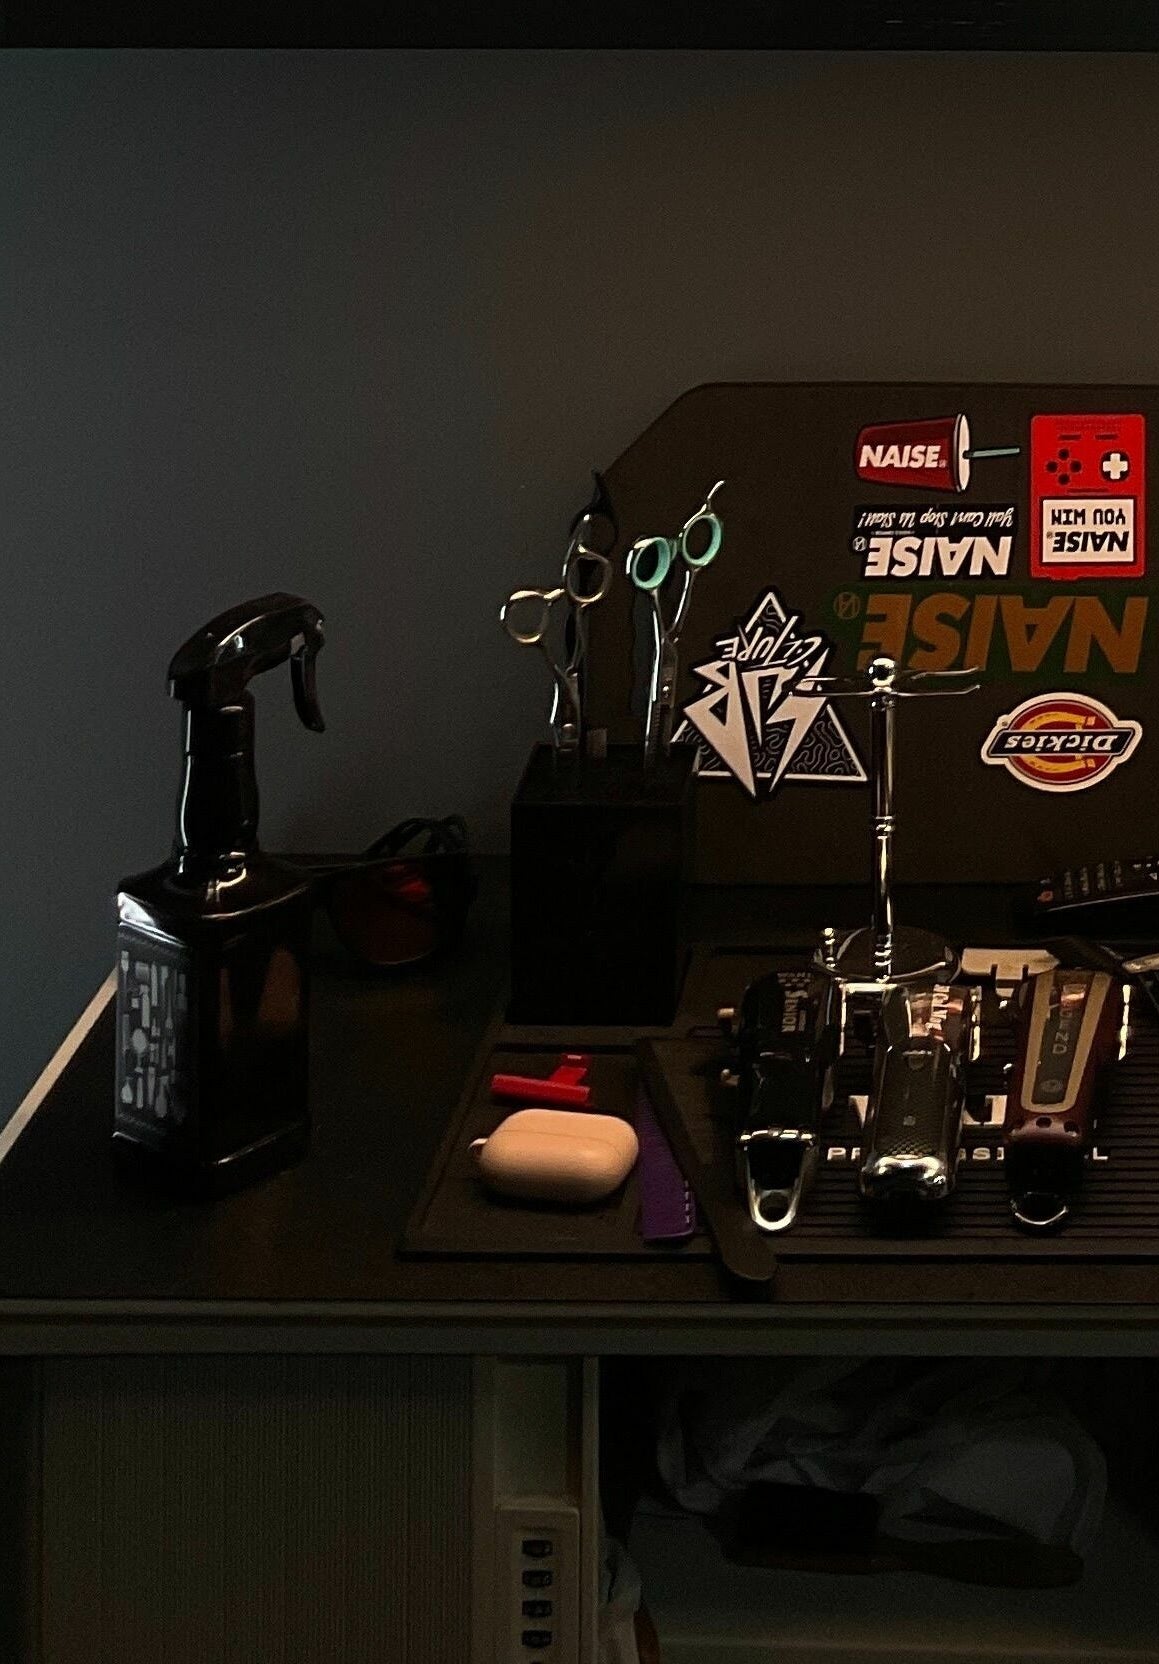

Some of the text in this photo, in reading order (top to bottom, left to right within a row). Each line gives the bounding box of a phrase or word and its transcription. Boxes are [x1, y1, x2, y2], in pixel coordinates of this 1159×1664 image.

[859, 445, 941, 468] NAISE
[898, 510, 916, 528] Us
[919, 507, 948, 529] Stop
[1051, 508, 1126, 525] YOU WIN
[1052, 531, 1129, 552] NAISE
[864, 536, 1013, 577] NAISE
[857, 593, 1149, 673] NAISE
[1003, 734, 1119, 752] Dickies
